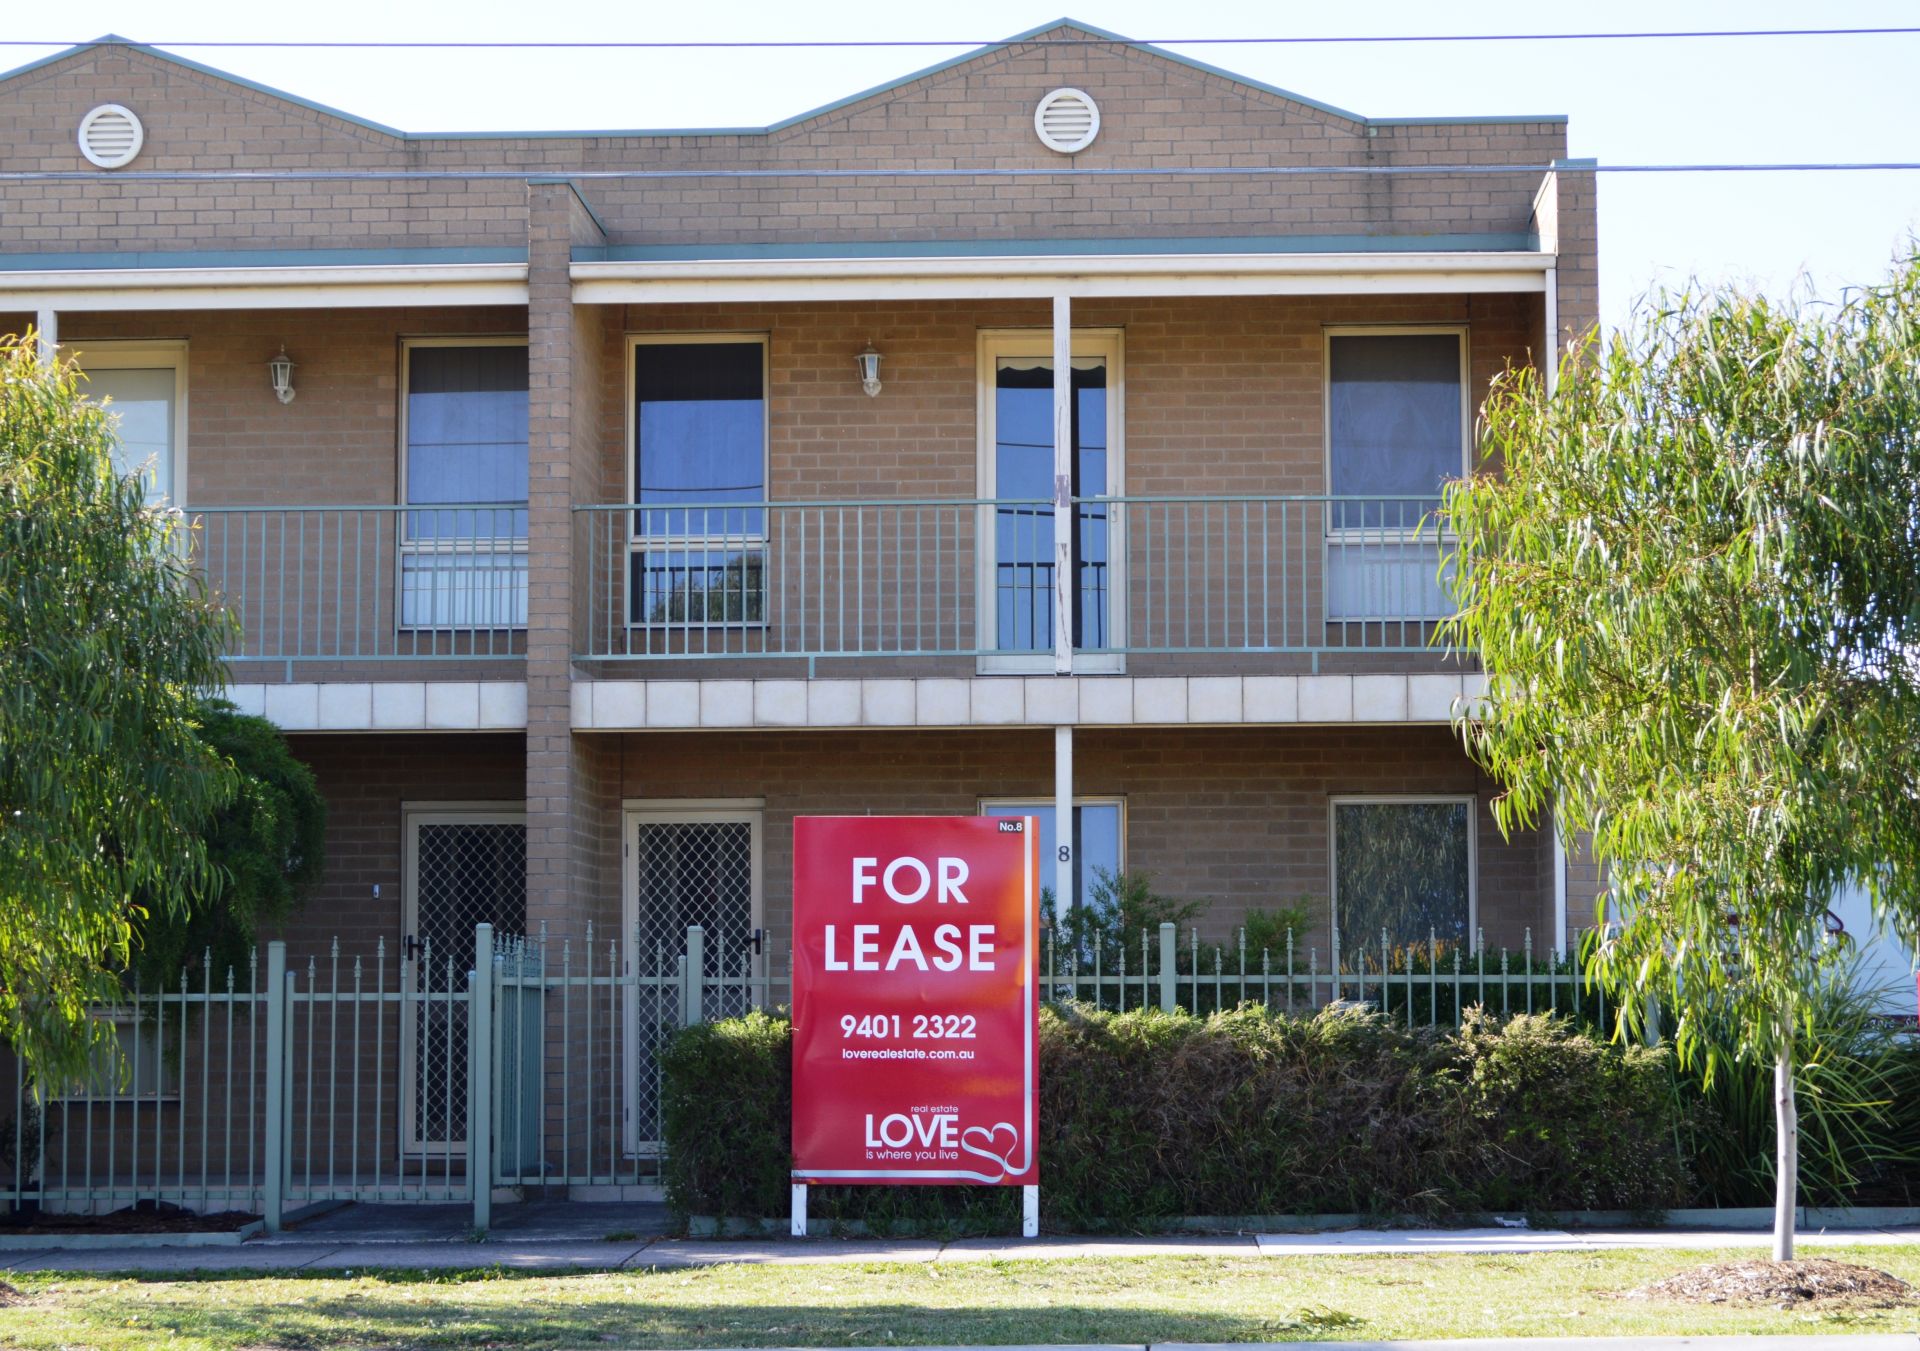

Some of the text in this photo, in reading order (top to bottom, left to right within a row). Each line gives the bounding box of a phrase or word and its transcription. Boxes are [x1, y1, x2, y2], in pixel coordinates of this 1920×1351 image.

[999, 822, 1023, 832] No.8
[1058, 845, 1070, 862] 8
[852, 856, 970, 905] FOR
[824, 924, 996, 973] LEASE
[840, 1014, 977, 1039] 9401 2322
[842, 1048, 975, 1060] loverealestate.com.au
[910, 1104, 959, 1113] real estate
[865, 1113, 959, 1148] LOVE
[865, 1149, 959, 1162] is where you live
